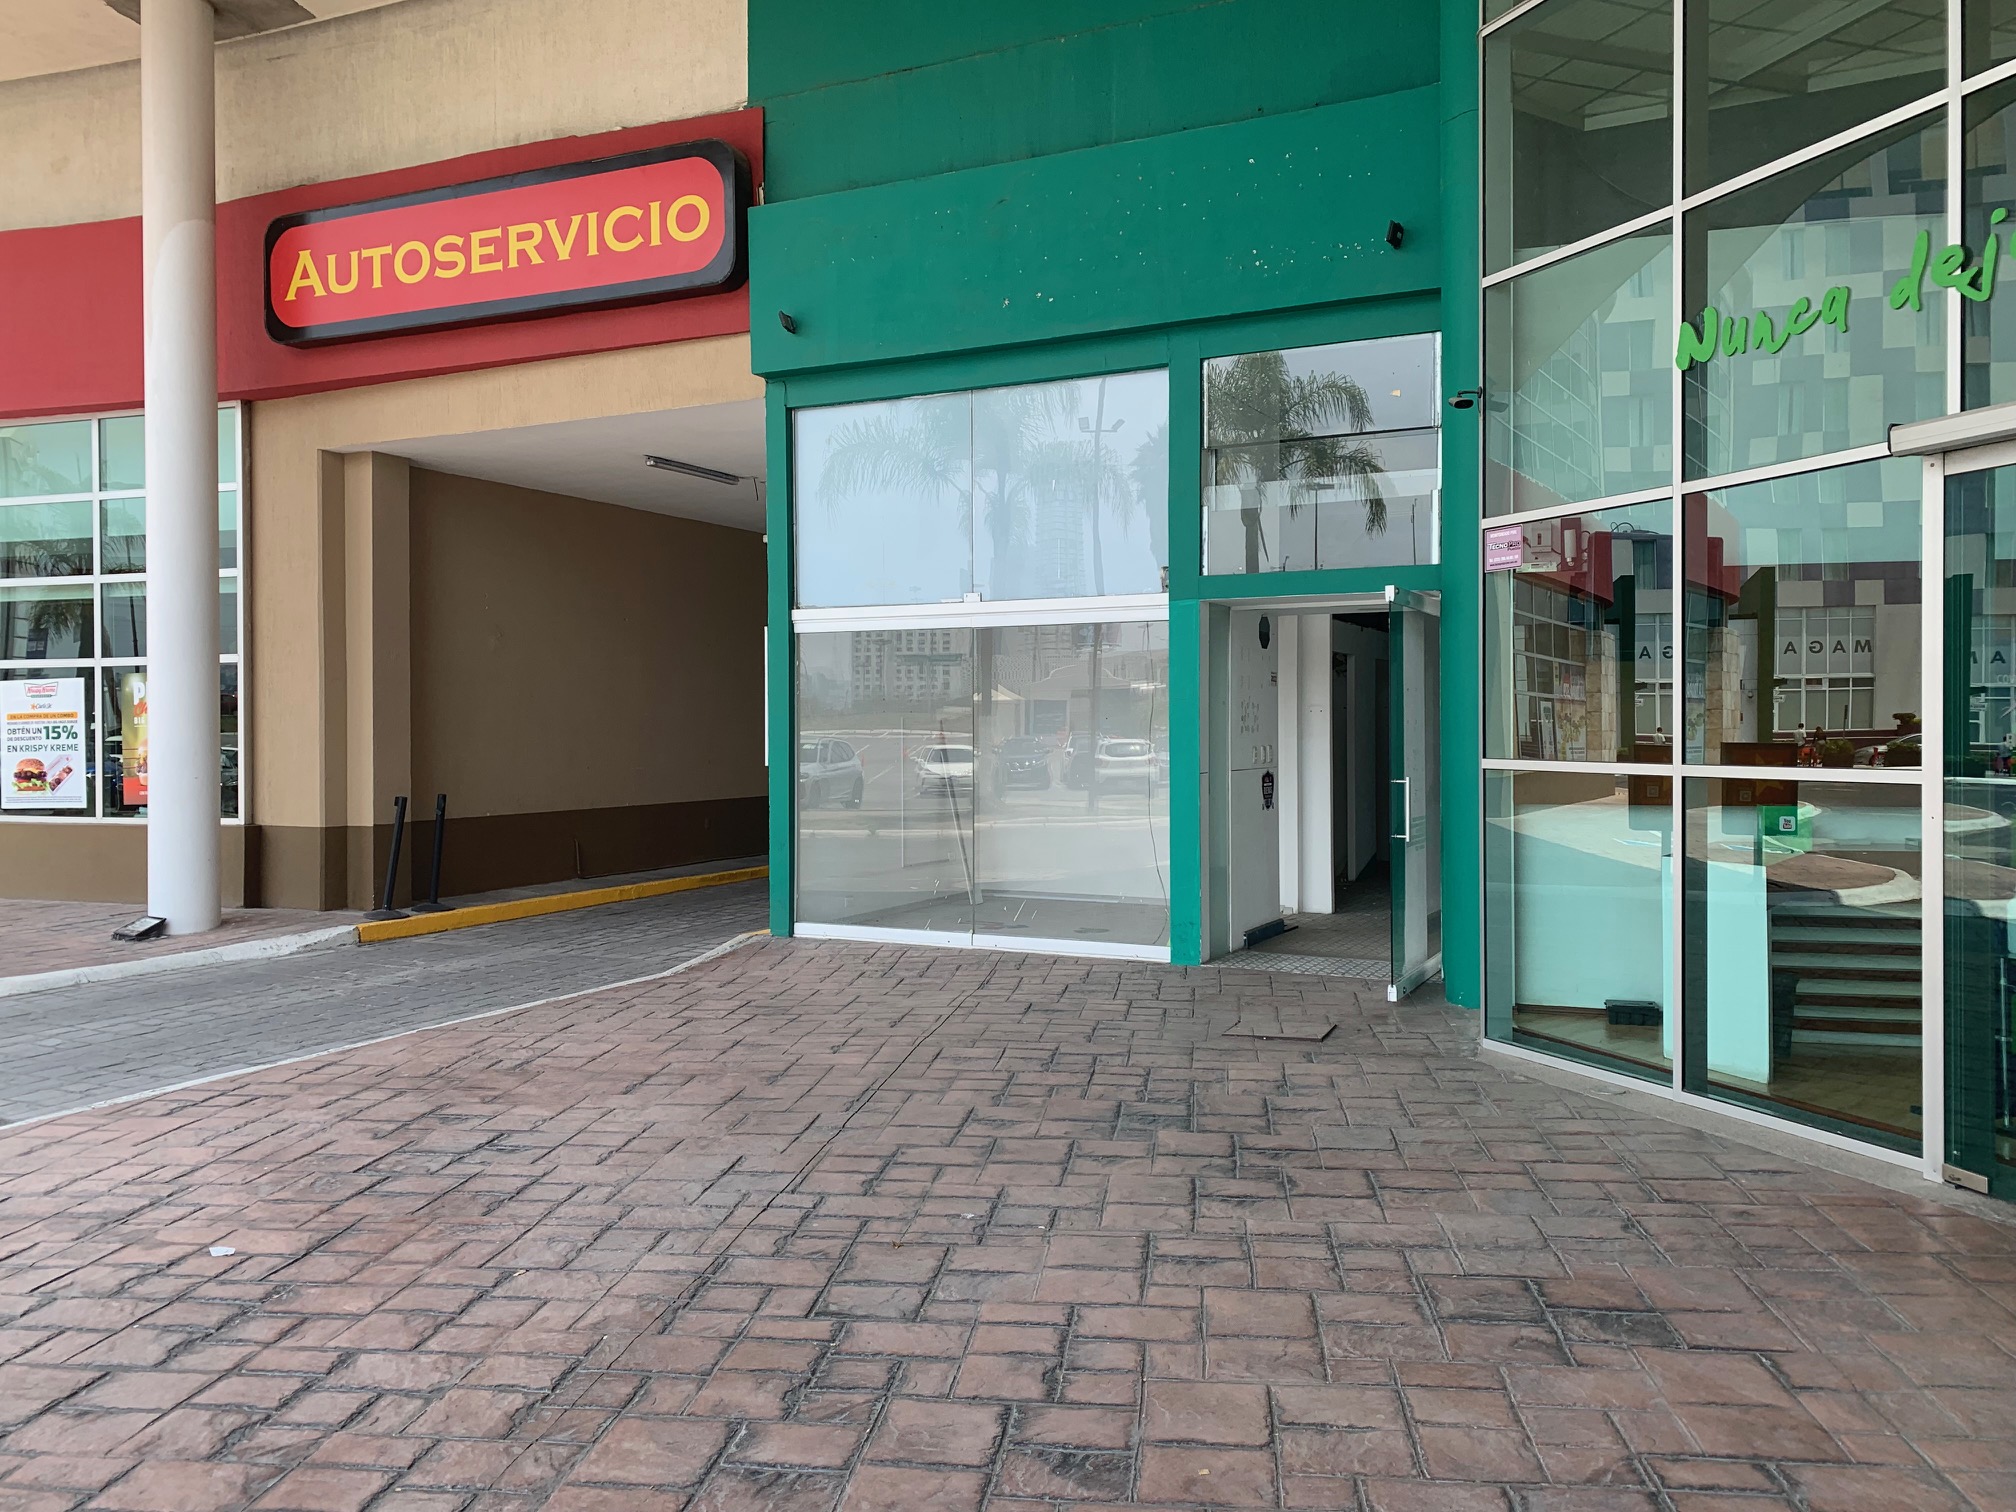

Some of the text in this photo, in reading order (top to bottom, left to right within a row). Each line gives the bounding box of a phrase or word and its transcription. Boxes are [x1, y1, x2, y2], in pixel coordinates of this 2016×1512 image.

[284, 194, 710, 301] AUTOSERVICIO
[1675, 207, 2016, 371] Nunca dej
[7, 726, 31, 735] OBTÉN
[43, 725, 78, 740] 15%
